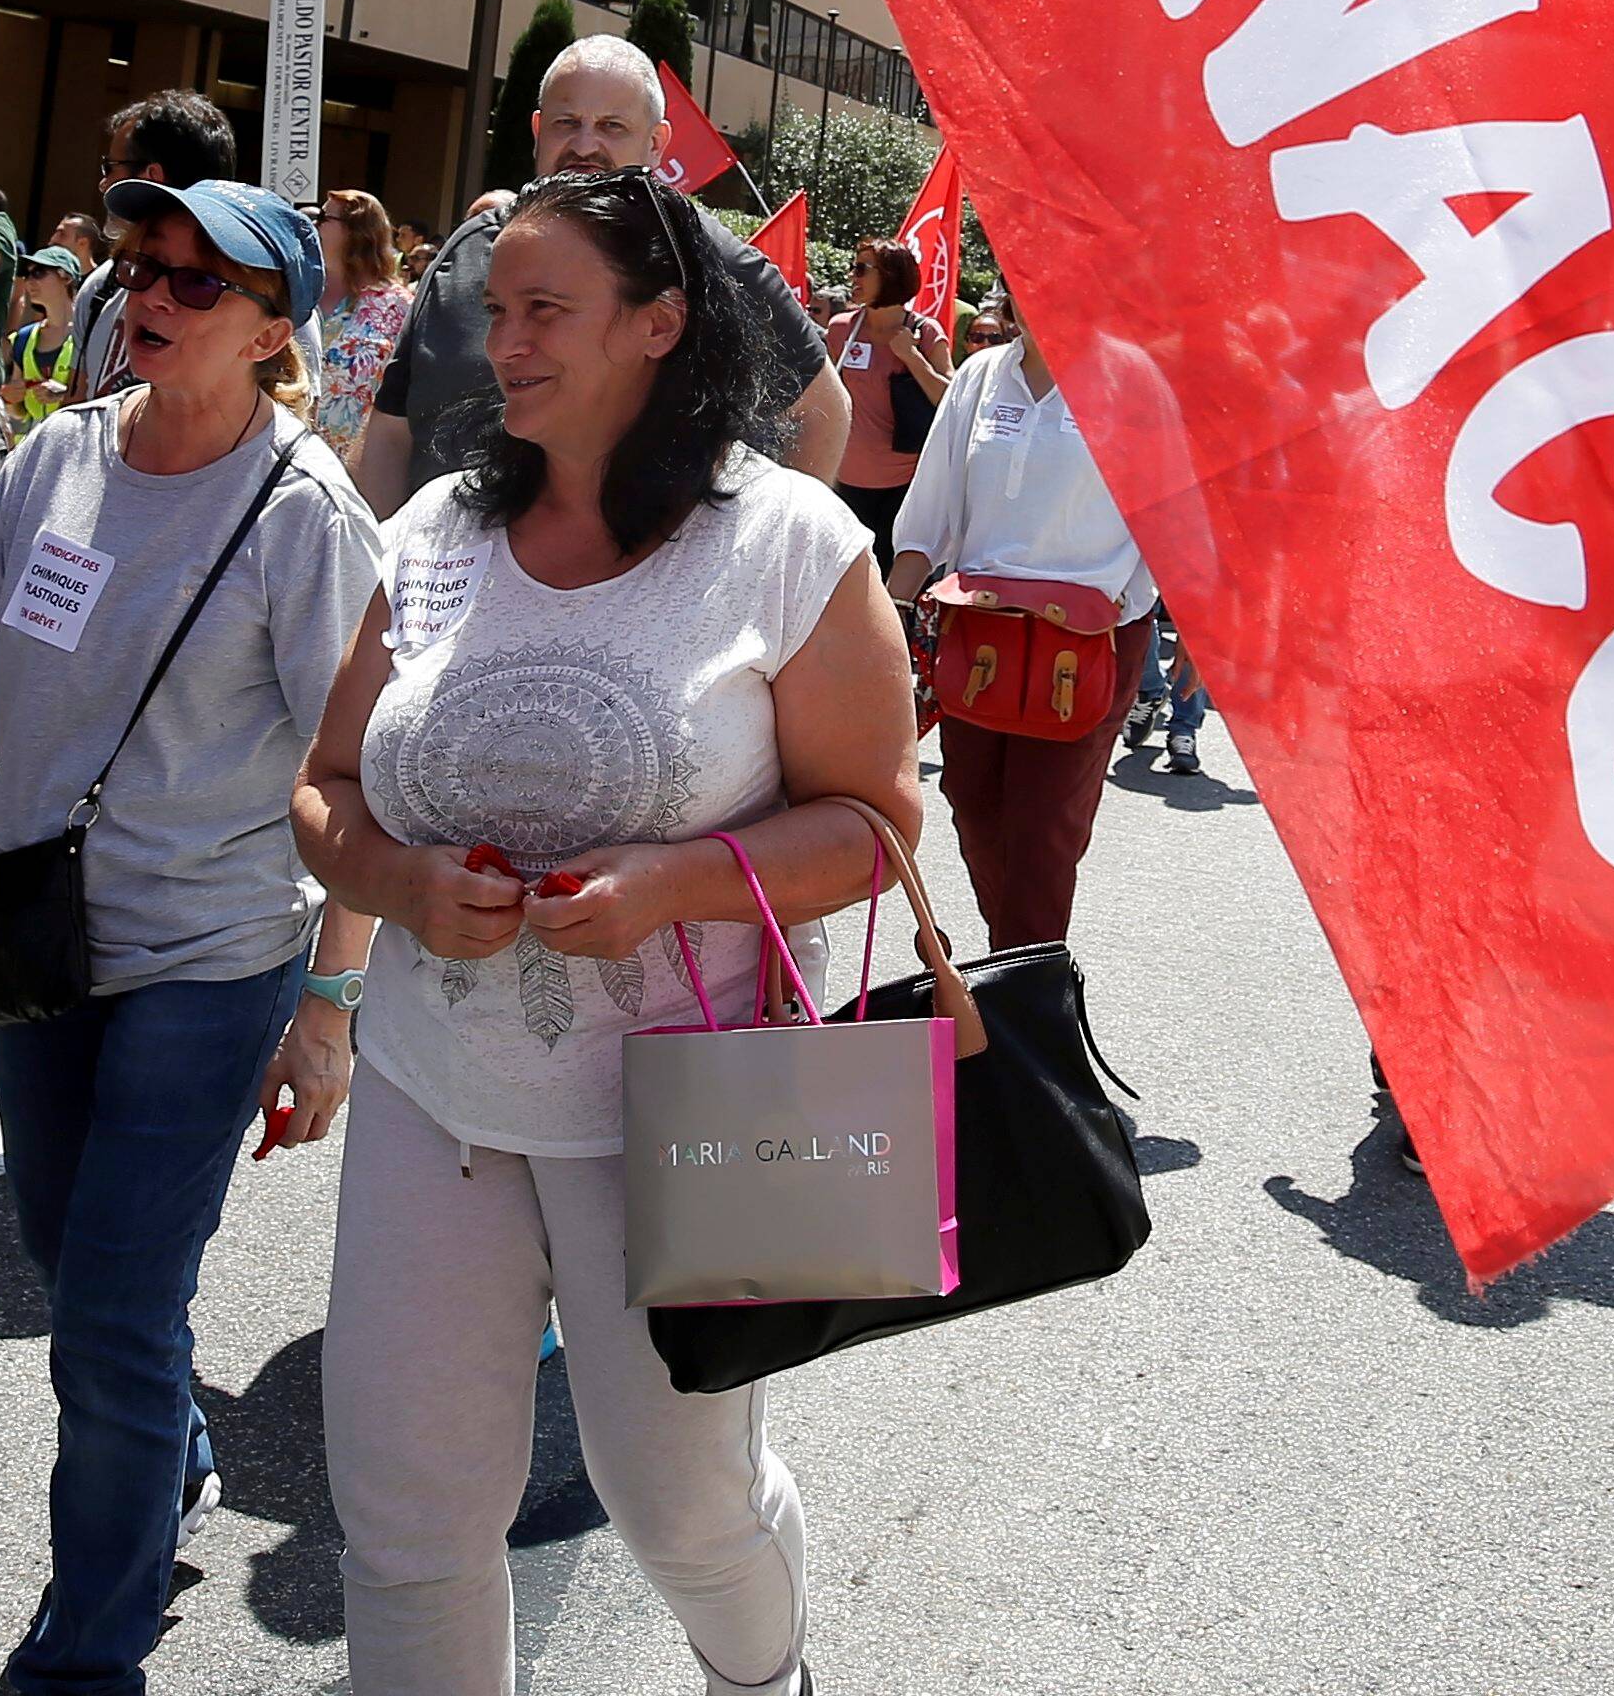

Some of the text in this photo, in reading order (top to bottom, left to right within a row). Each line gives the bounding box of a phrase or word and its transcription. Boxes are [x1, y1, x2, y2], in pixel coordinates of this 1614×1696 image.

[291, 33, 314, 91] PASTOR
[41, 542, 101, 573] SYNDICAT DES
[400, 556, 476, 571] SYNDICAT DES
[31, 563, 89, 596] CHIMIQUES
[397, 577, 469, 594] CHIMIQUES
[23, 581, 81, 614] PLASTIQUES
[28, 610, 56, 631] GRÈVE
[658, 1140, 742, 1167] MARIA
